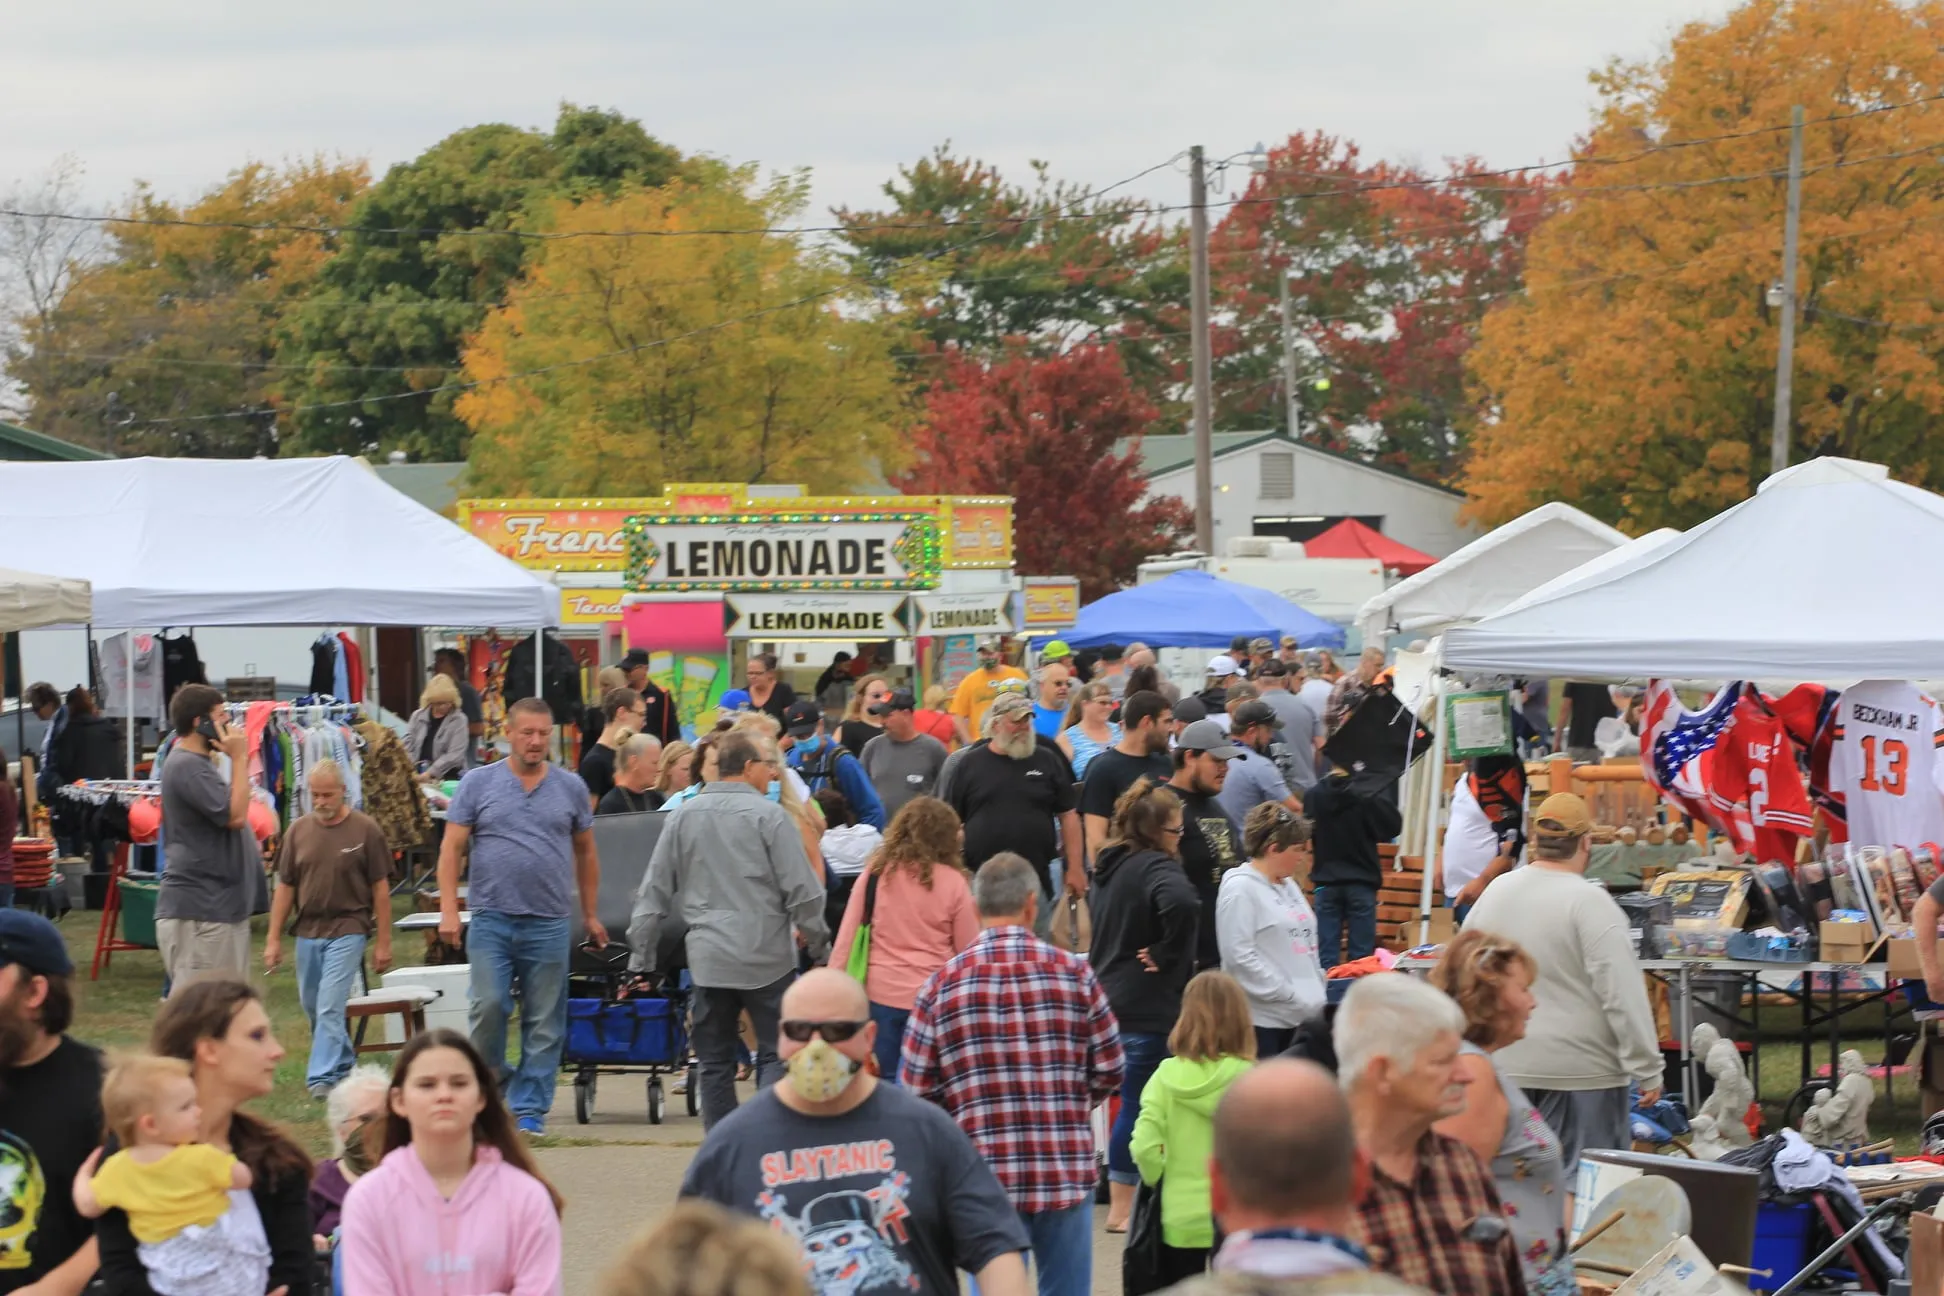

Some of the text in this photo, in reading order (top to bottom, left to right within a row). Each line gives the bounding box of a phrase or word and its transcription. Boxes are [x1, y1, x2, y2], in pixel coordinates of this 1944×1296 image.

[666, 538, 885, 577] LEMONADE
[749, 612, 885, 630] LEMONADE
[930, 608, 999, 629] LEMONADE
[1852, 703, 1919, 731] BECKHAM JR
[1860, 734, 1910, 797] 13
[1748, 767, 1769, 827] 2
[760, 1138, 896, 1188] SLAYTANIC
